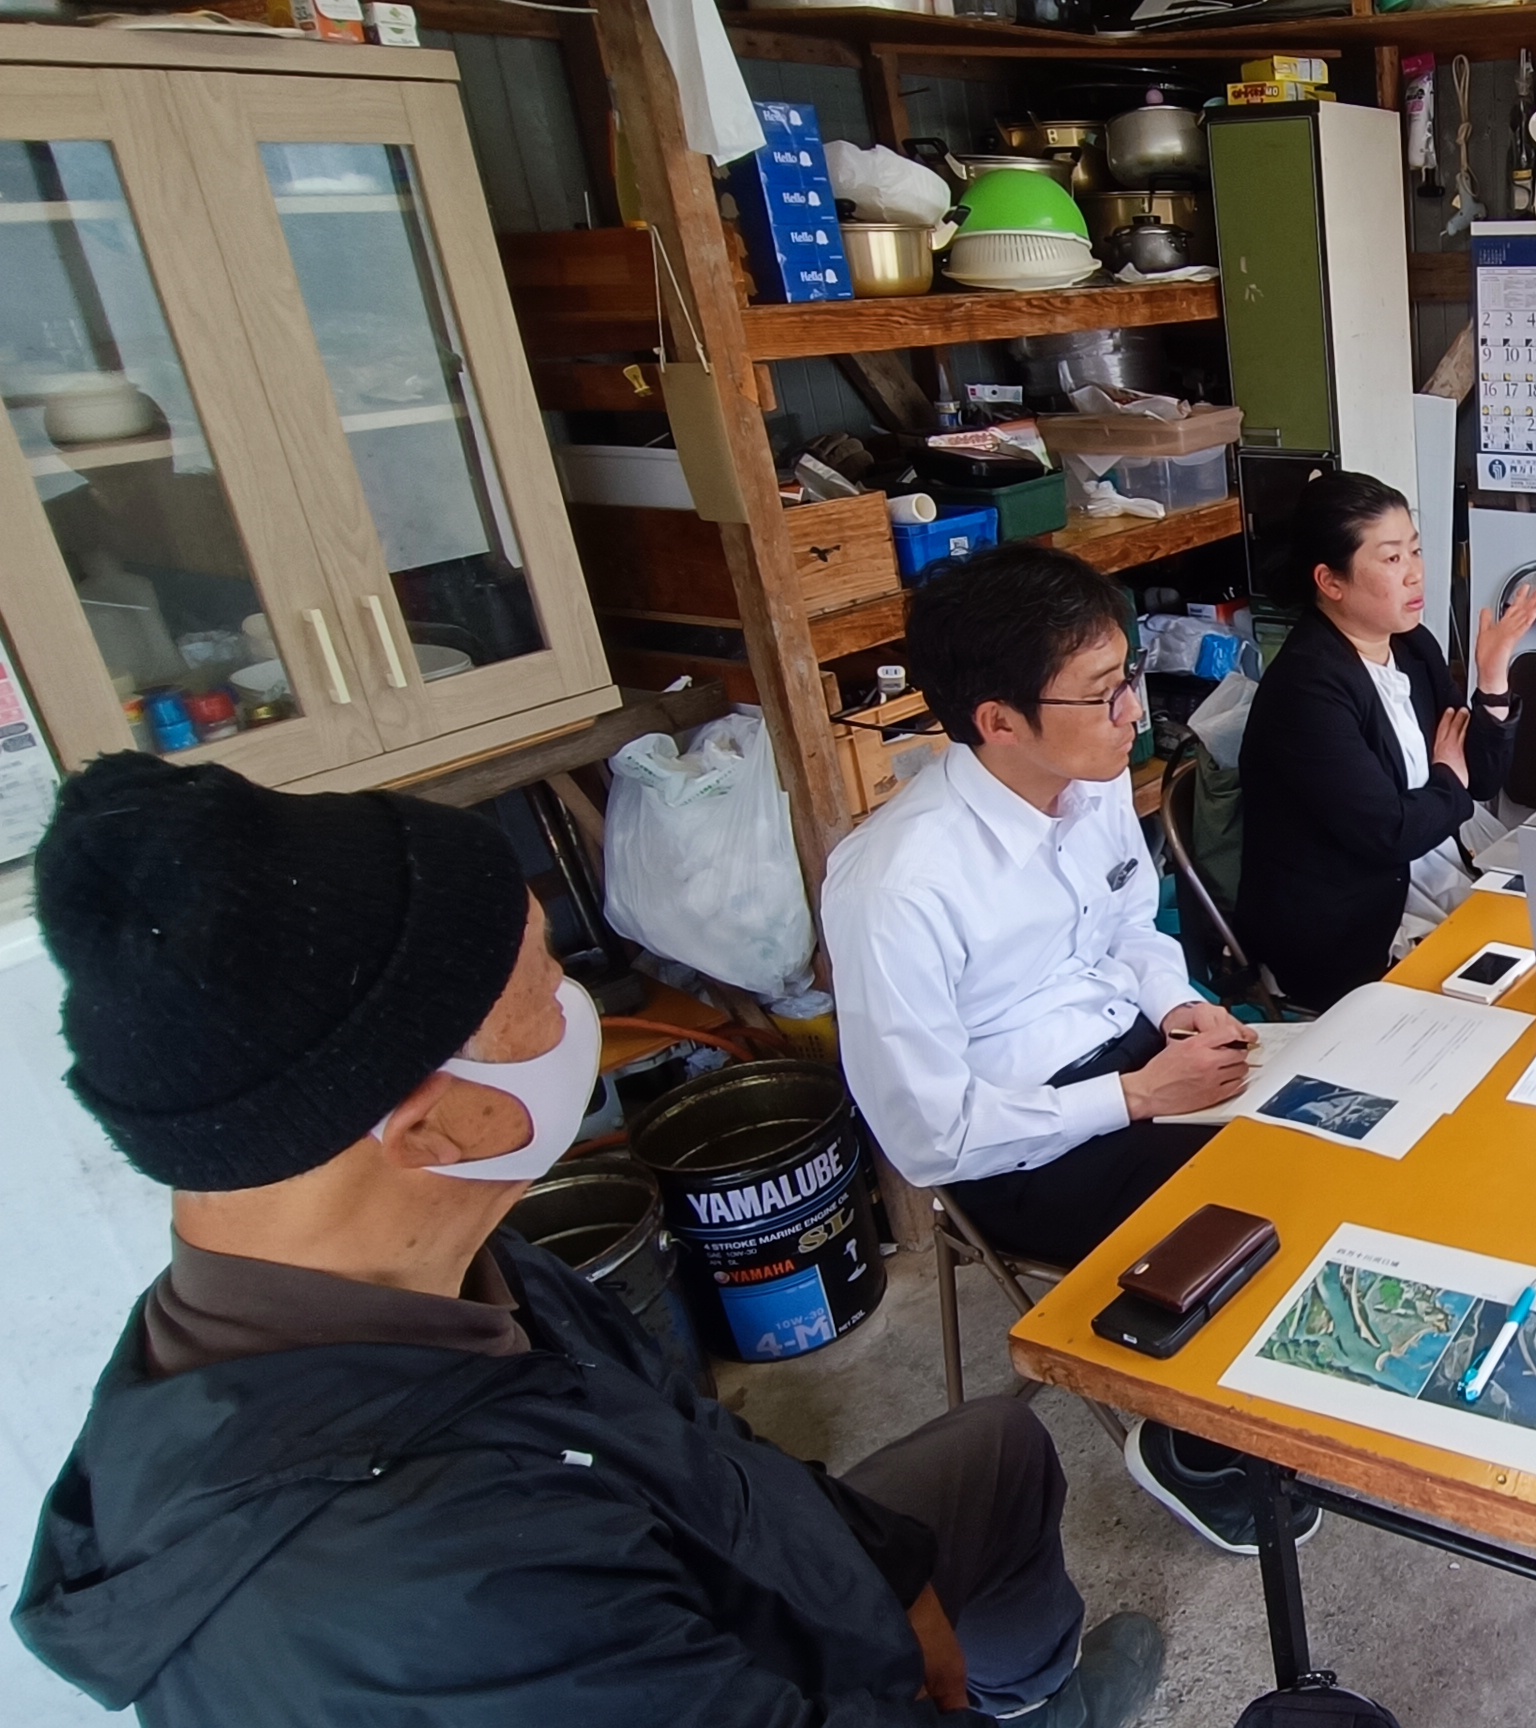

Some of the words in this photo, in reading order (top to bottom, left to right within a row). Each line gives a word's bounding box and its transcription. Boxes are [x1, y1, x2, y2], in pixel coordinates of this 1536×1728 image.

[773, 151, 797, 163] Hello
[782, 192, 806, 203] Hello
[790, 232, 814, 243] Hello
[800, 271, 823, 282] Hello
[1482, 312, 1490, 327] 2
[1505, 313, 1513, 327] 3
[1527, 313, 1536, 327] 4
[1482, 348, 1492, 362] 9
[1505, 348, 1519, 362] 10
[1483, 383, 1497, 397] 16
[1505, 383, 1518, 397] 17
[686, 1142, 843, 1224] YAMALUBE
[711, 1238, 757, 1252] STROKE
[758, 1222, 803, 1245] MARINE
[803, 1201, 838, 1228] ENGINE
[797, 1206, 855, 1254] SL
[729, 1259, 795, 1283] YAMAHA
[776, 1307, 825, 1330] 10W-30
[756, 1315, 832, 1357] 4-M
